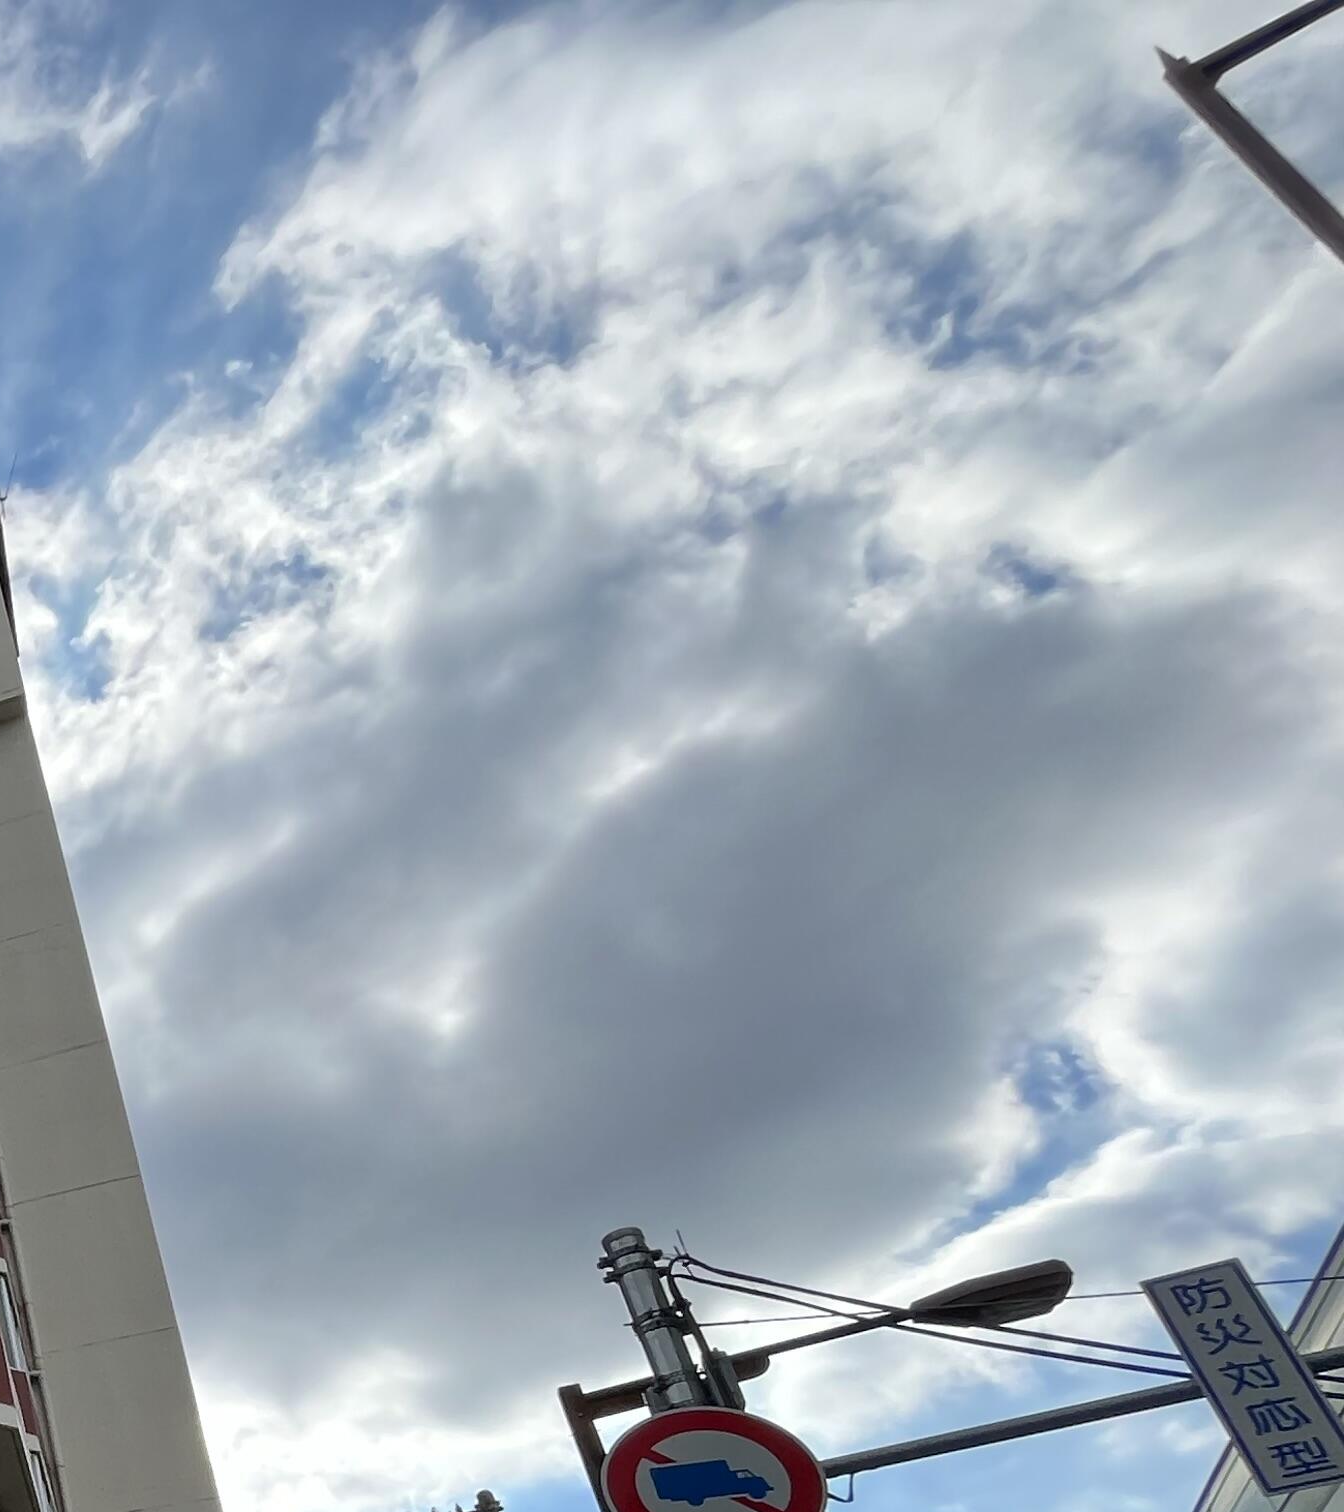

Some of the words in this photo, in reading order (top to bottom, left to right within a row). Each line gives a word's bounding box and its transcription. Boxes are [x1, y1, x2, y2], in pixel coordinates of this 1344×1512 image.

[1170, 1277, 1339, 1478] 防災対応型
